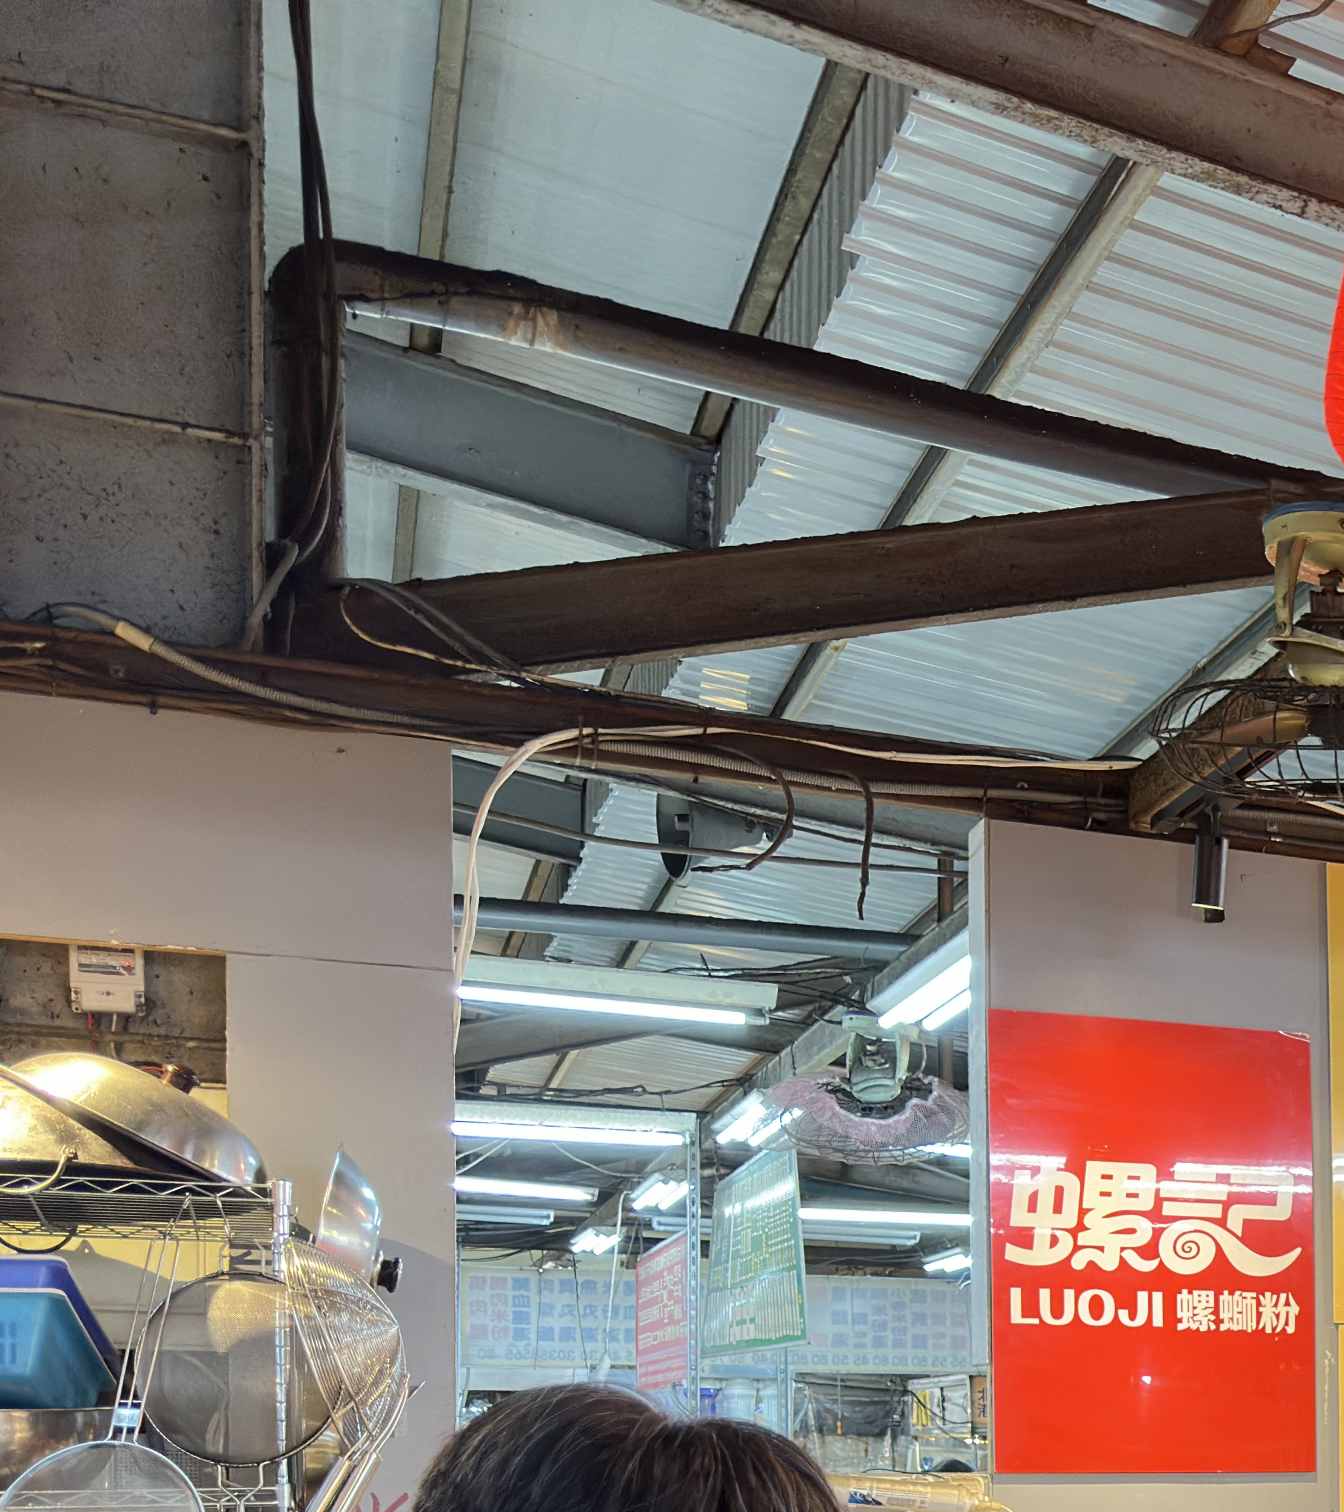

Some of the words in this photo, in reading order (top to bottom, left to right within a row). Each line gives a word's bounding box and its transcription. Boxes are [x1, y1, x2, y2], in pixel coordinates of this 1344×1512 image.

[1004, 1160, 1302, 1278] 螺記
[1009, 1289, 1164, 1327] LUOJI
[1176, 1288, 1299, 1335] 螺螄粉
